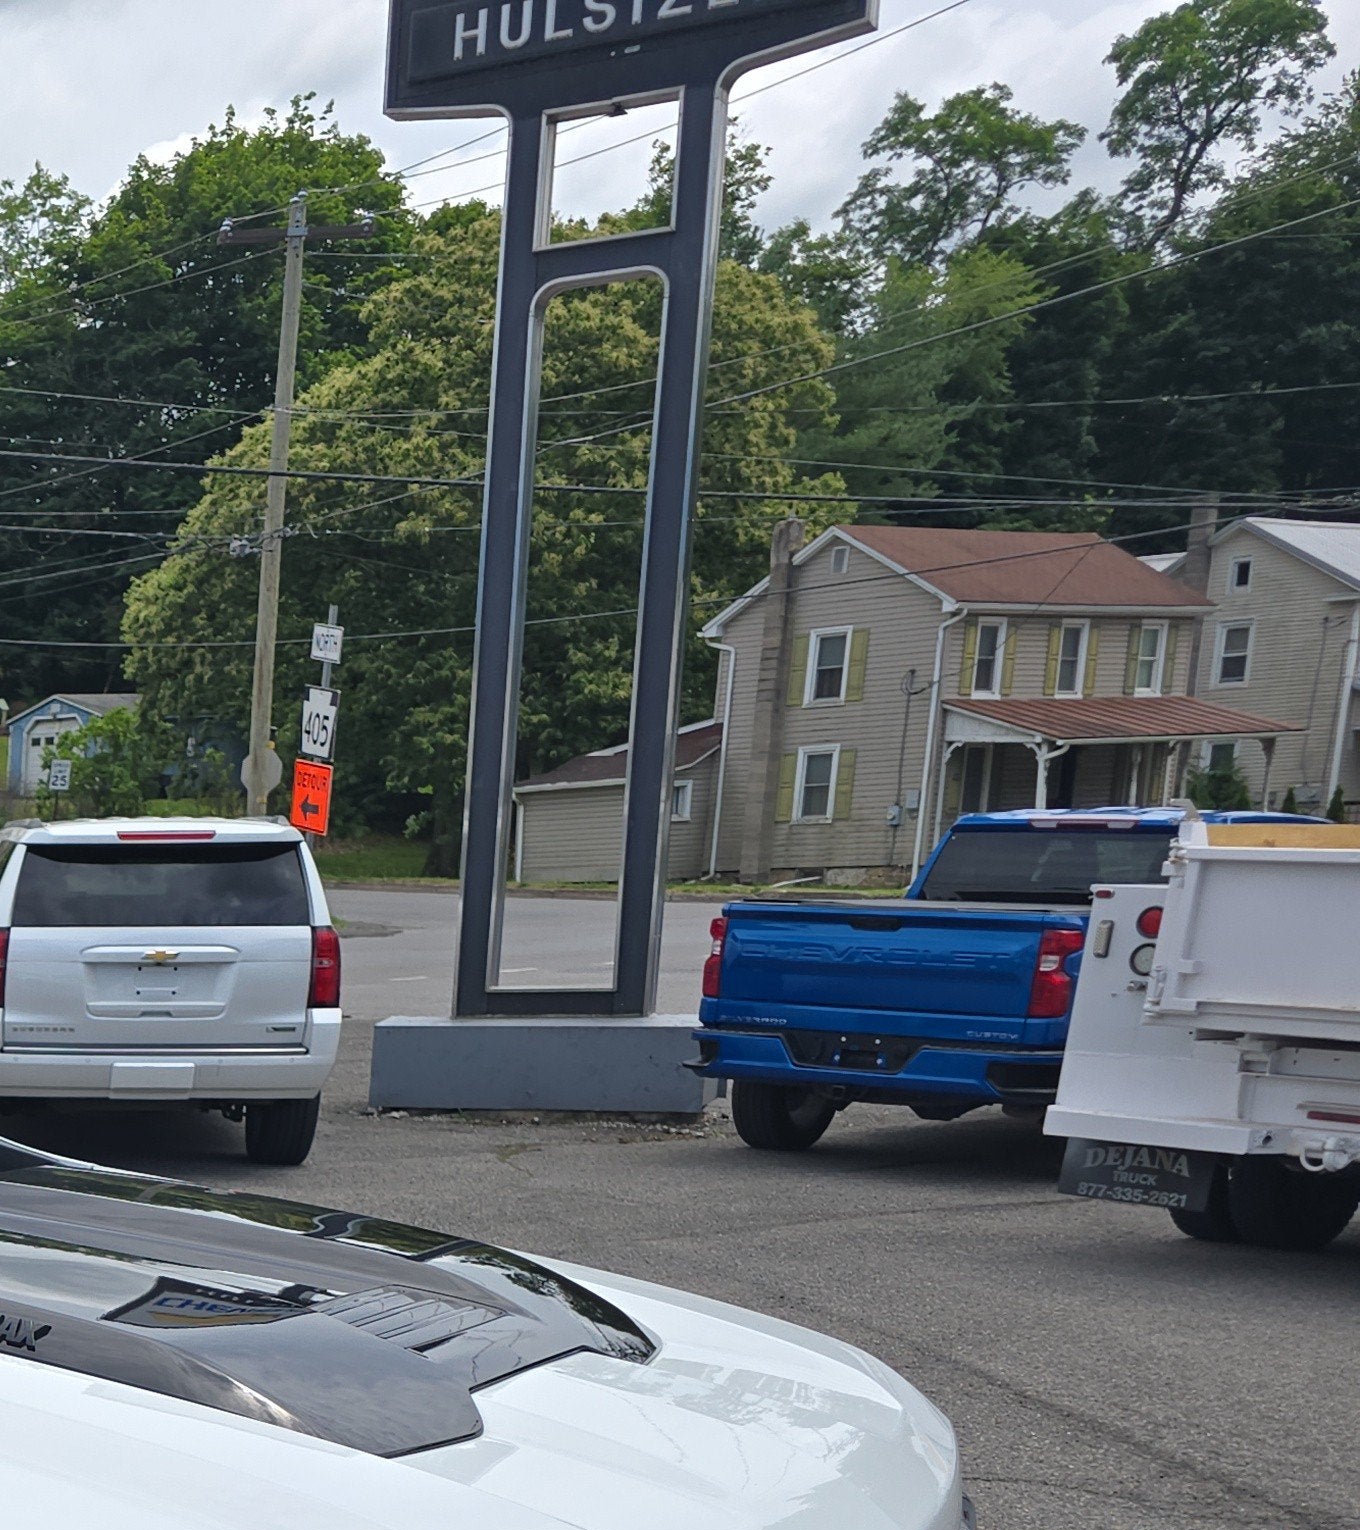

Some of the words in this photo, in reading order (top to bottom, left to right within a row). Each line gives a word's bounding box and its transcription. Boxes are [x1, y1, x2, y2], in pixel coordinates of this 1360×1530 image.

[453, 0, 740, 60] HULSI
[304, 712, 330, 747] 405
[51, 774, 67, 787] 25
[297, 770, 328, 791] DETOUR
[1083, 1145, 1191, 1178] DEJANA
[1112, 1170, 1158, 1186] TRUCK
[1077, 1181, 1188, 1208] 877-335-2621
